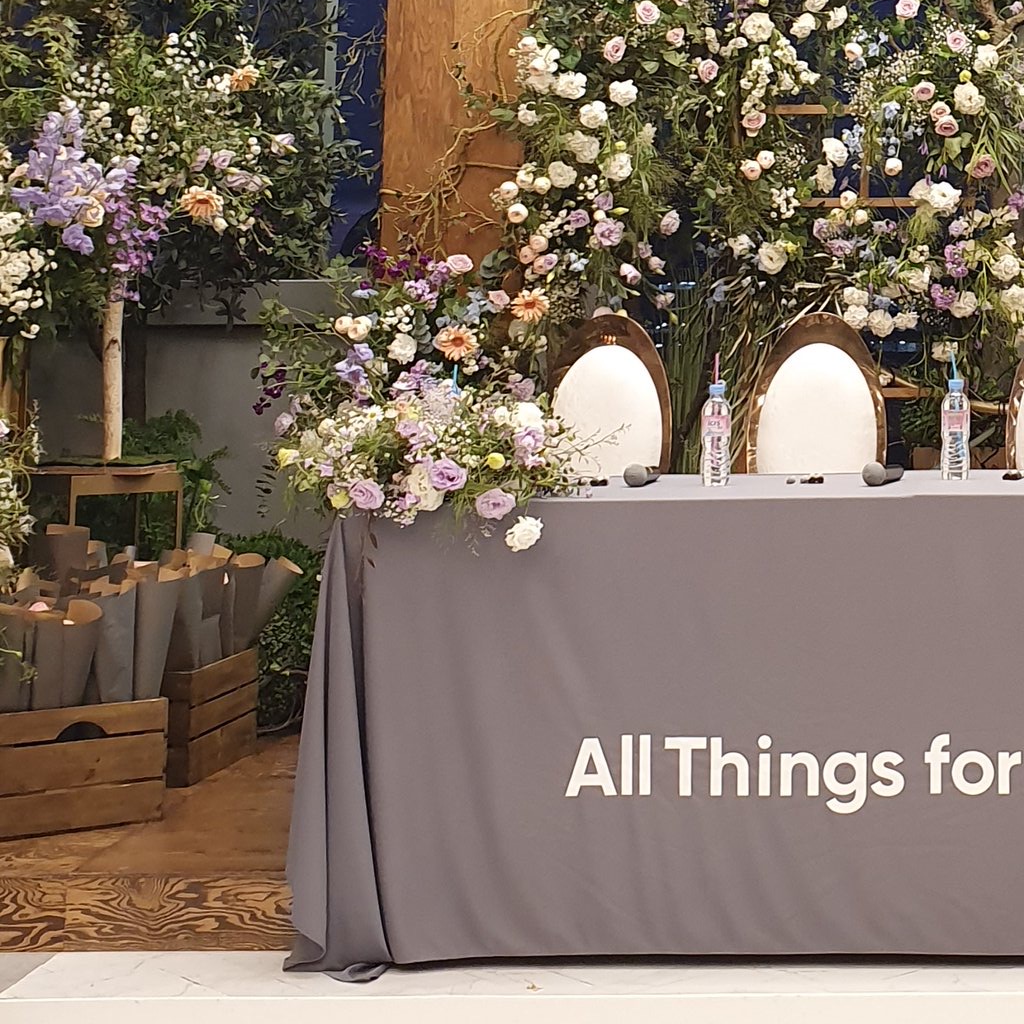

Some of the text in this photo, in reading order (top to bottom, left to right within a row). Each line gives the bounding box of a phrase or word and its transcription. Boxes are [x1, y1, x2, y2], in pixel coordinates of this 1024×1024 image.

[564, 734, 652, 797] All
[664, 734, 905, 814] Things
[924, 733, 1022, 796] for
